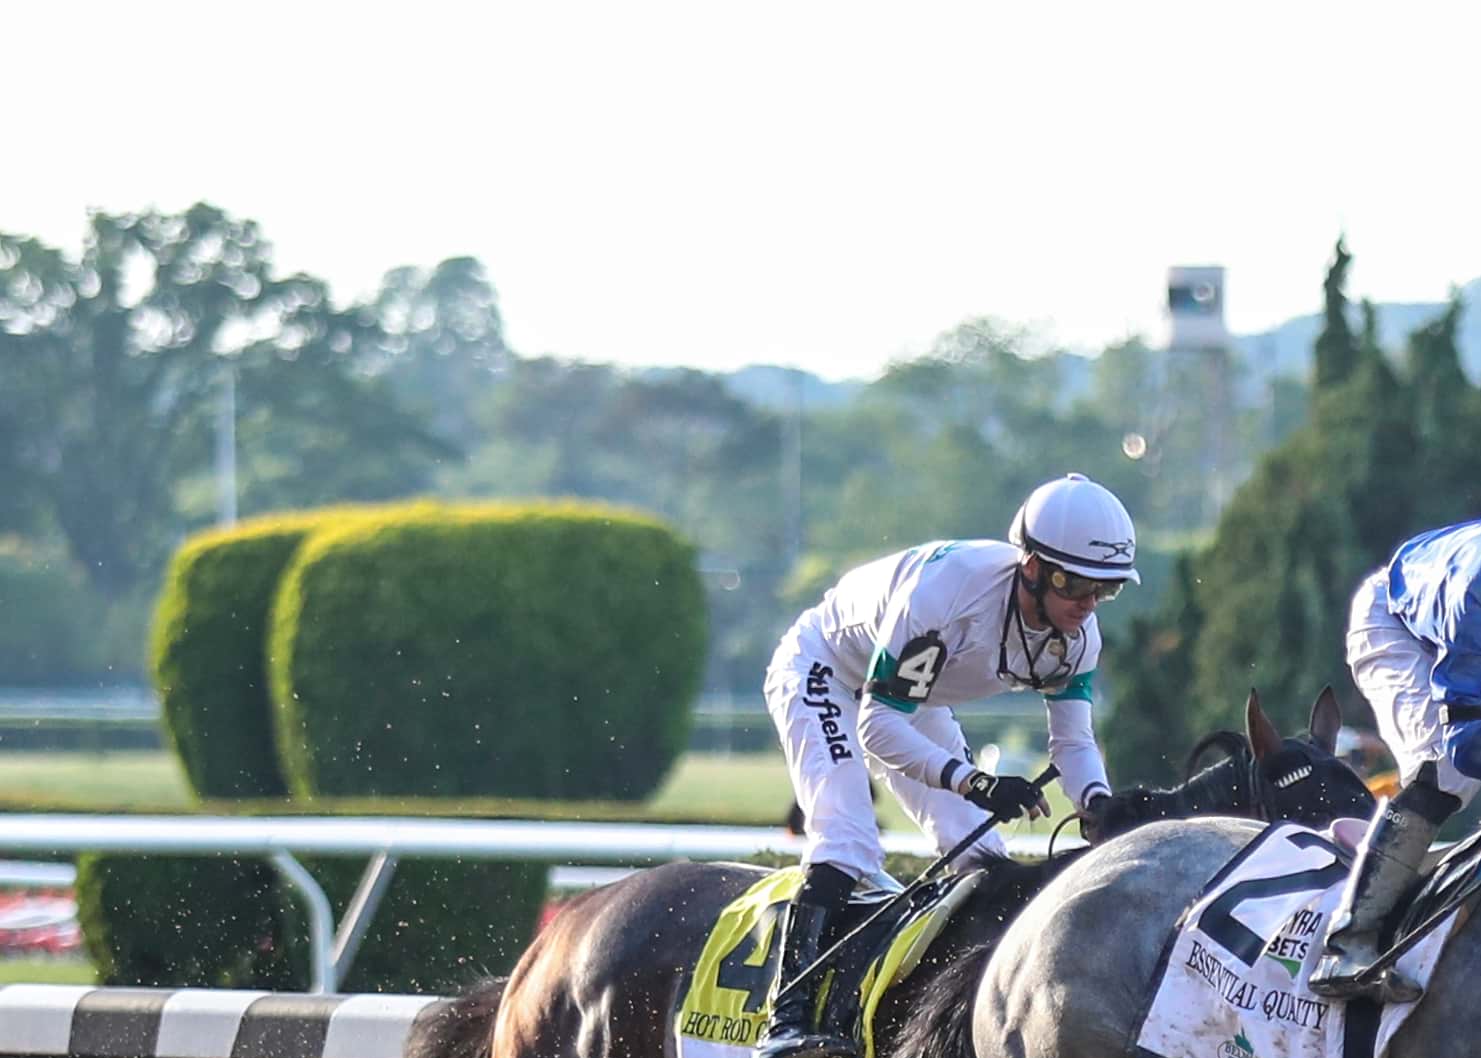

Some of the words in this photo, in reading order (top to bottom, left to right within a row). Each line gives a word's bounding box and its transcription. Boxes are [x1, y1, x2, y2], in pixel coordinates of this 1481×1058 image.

[897, 645, 941, 698] 4
[1198, 831, 1352, 968] 2
[1281, 909, 1323, 937] YRA
[717, 900, 787, 1014] 4
[1186, 940, 1258, 1010] ESSENTIAL
[682, 1011, 720, 1039] HOT
[721, 1016, 752, 1042] ROD
